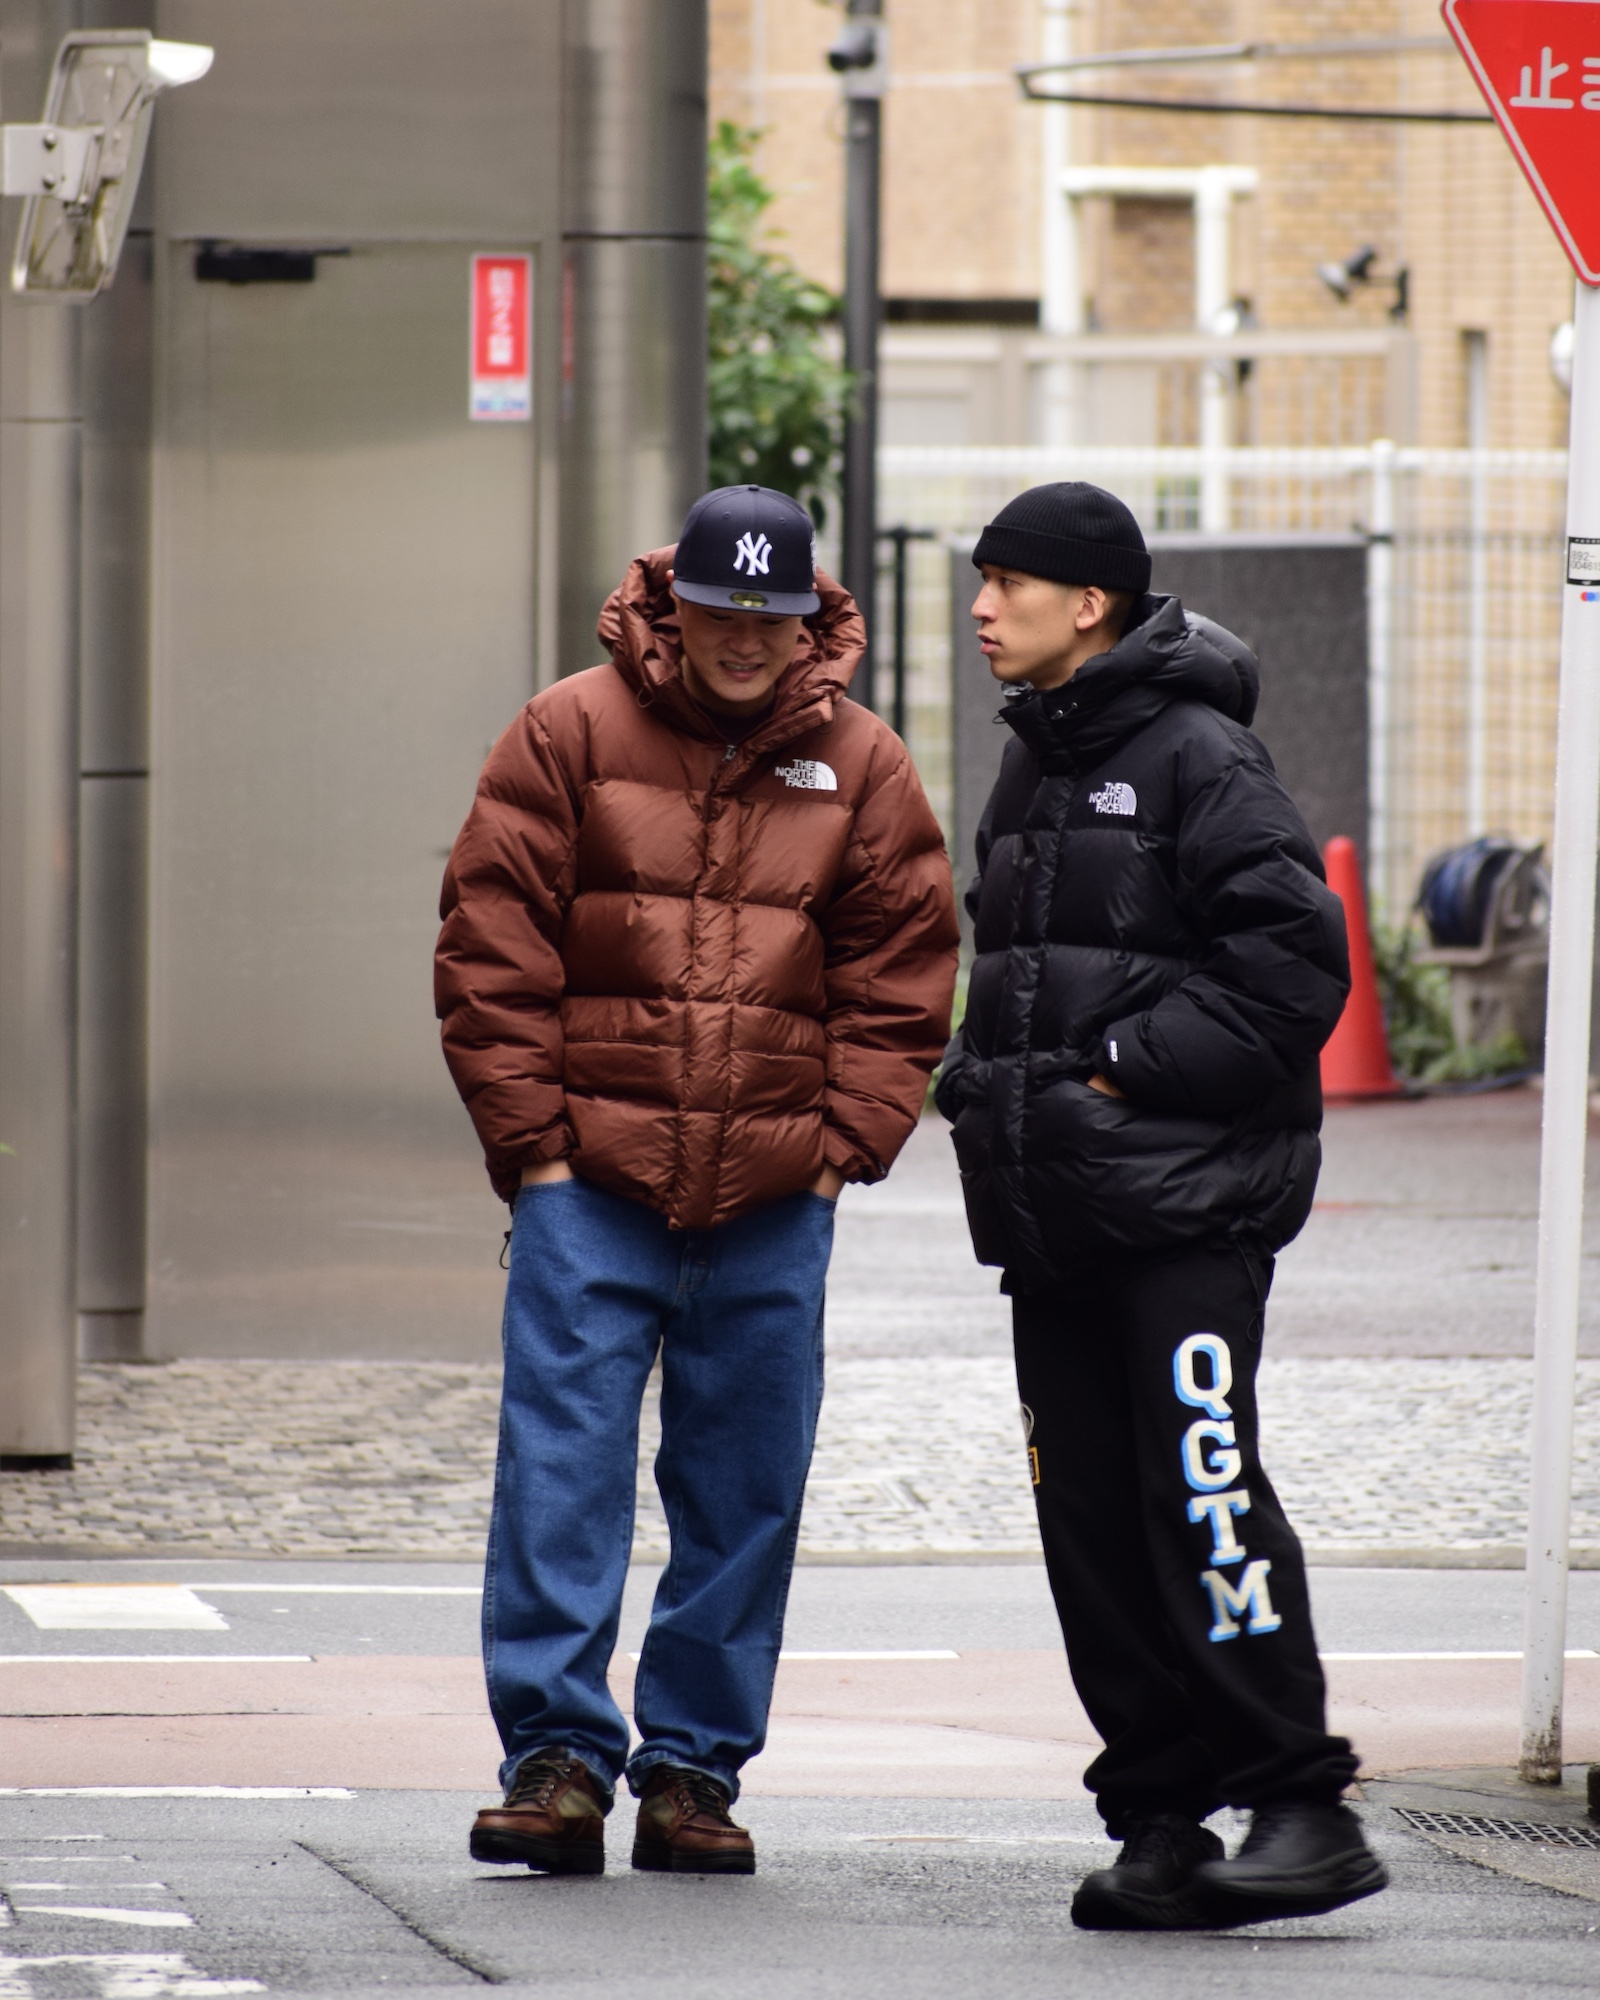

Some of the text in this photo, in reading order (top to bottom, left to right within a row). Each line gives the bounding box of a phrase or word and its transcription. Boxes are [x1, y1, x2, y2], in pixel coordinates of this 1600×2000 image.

[733, 531, 773, 576] NY
[792, 759, 816, 770] THE
[774, 766, 817, 780] NORTH
[785, 776, 816, 789] FACE
[1104, 781, 1123, 794] THE
[1088, 791, 1122, 804] NORTH
[1095, 803, 1121, 815] FACE
